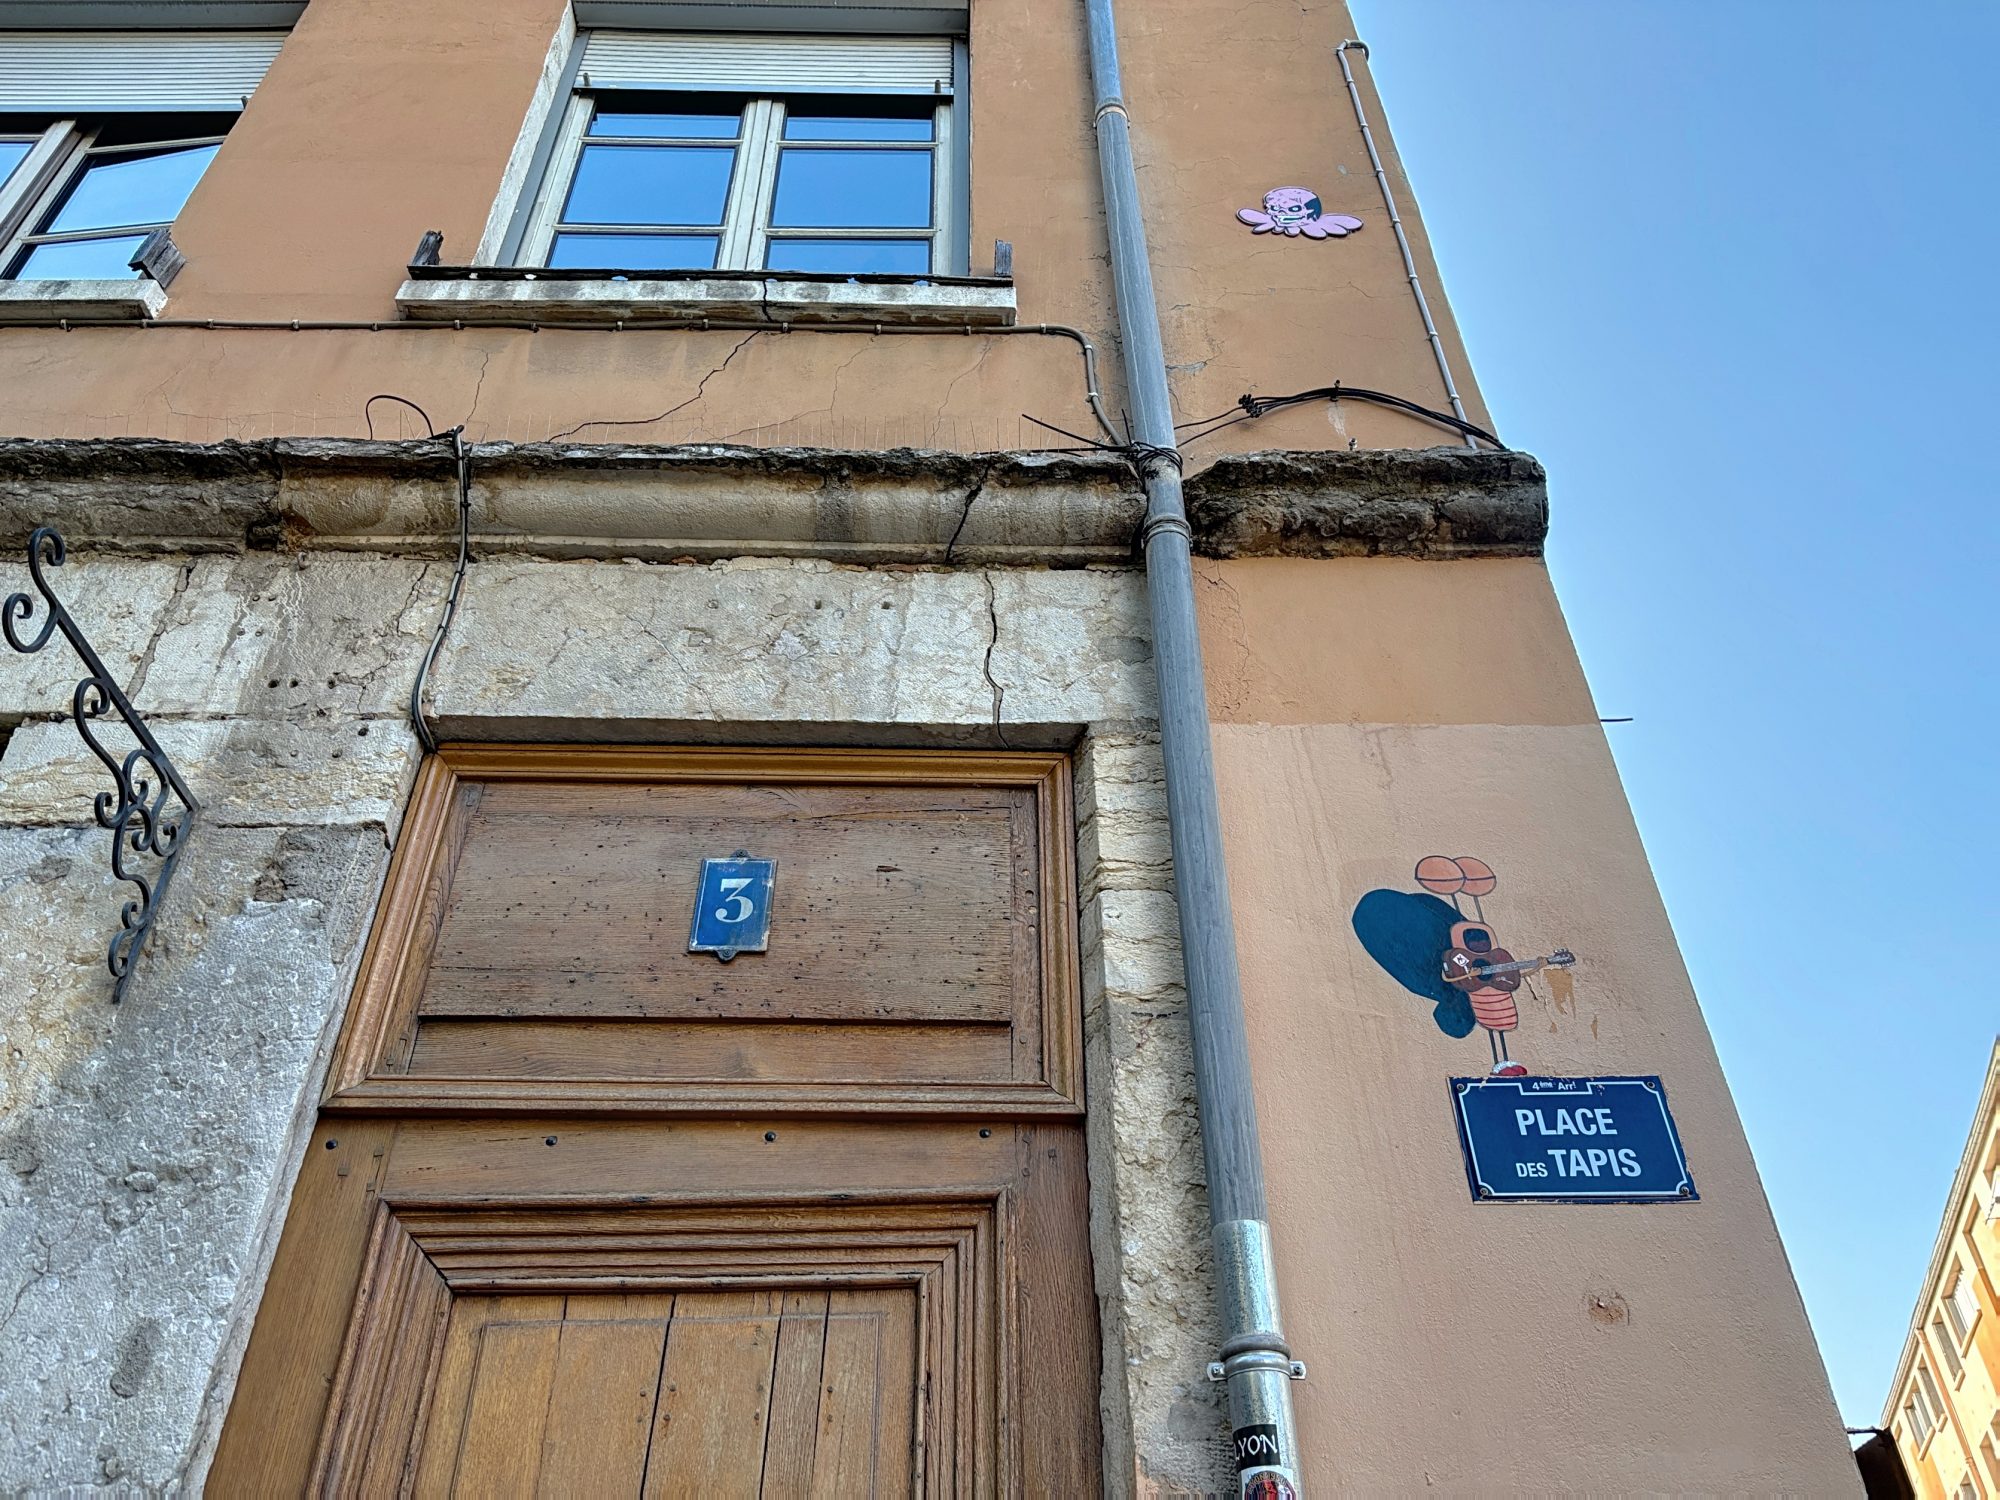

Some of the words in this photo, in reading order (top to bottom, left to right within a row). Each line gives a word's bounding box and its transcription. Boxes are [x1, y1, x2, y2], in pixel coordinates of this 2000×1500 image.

[715, 878, 754, 923] 3
[1515, 1108, 1618, 1136] PLACE
[1515, 1162, 1549, 1178] DES
[1547, 1148, 1642, 1178] TAPIS
